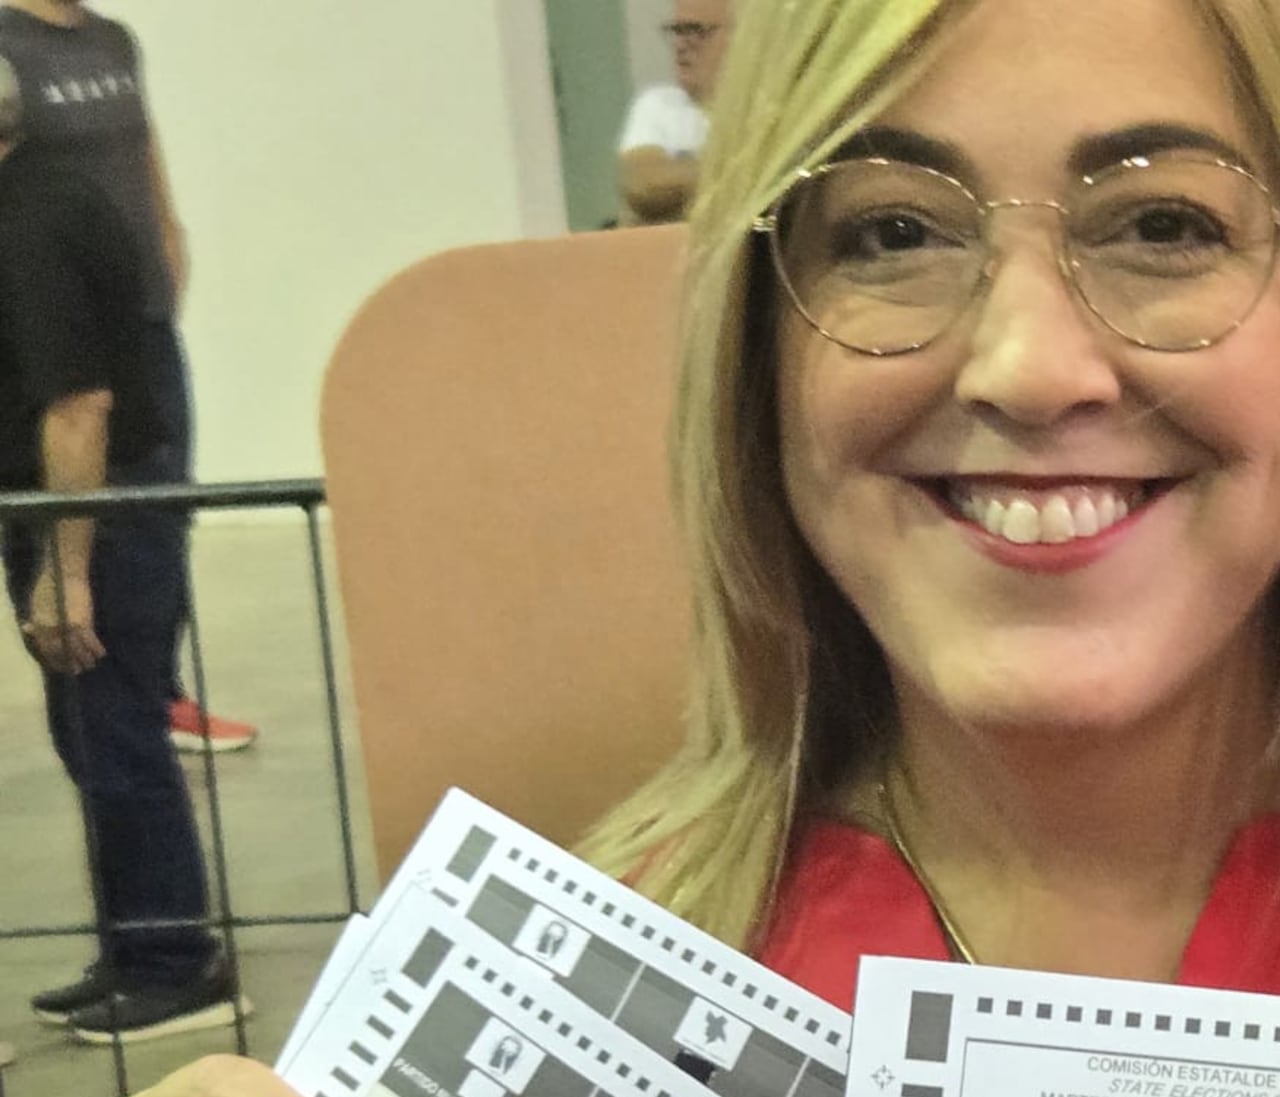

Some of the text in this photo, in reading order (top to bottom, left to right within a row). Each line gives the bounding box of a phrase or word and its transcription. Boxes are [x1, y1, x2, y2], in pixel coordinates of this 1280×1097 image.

[1088, 1056, 1172, 1078] COMISIÓN
[1178, 1064, 1252, 1086] ESTATAL
[1254, 1074, 1276, 1089] DE
[1109, 1078, 1164, 1097] STATE
